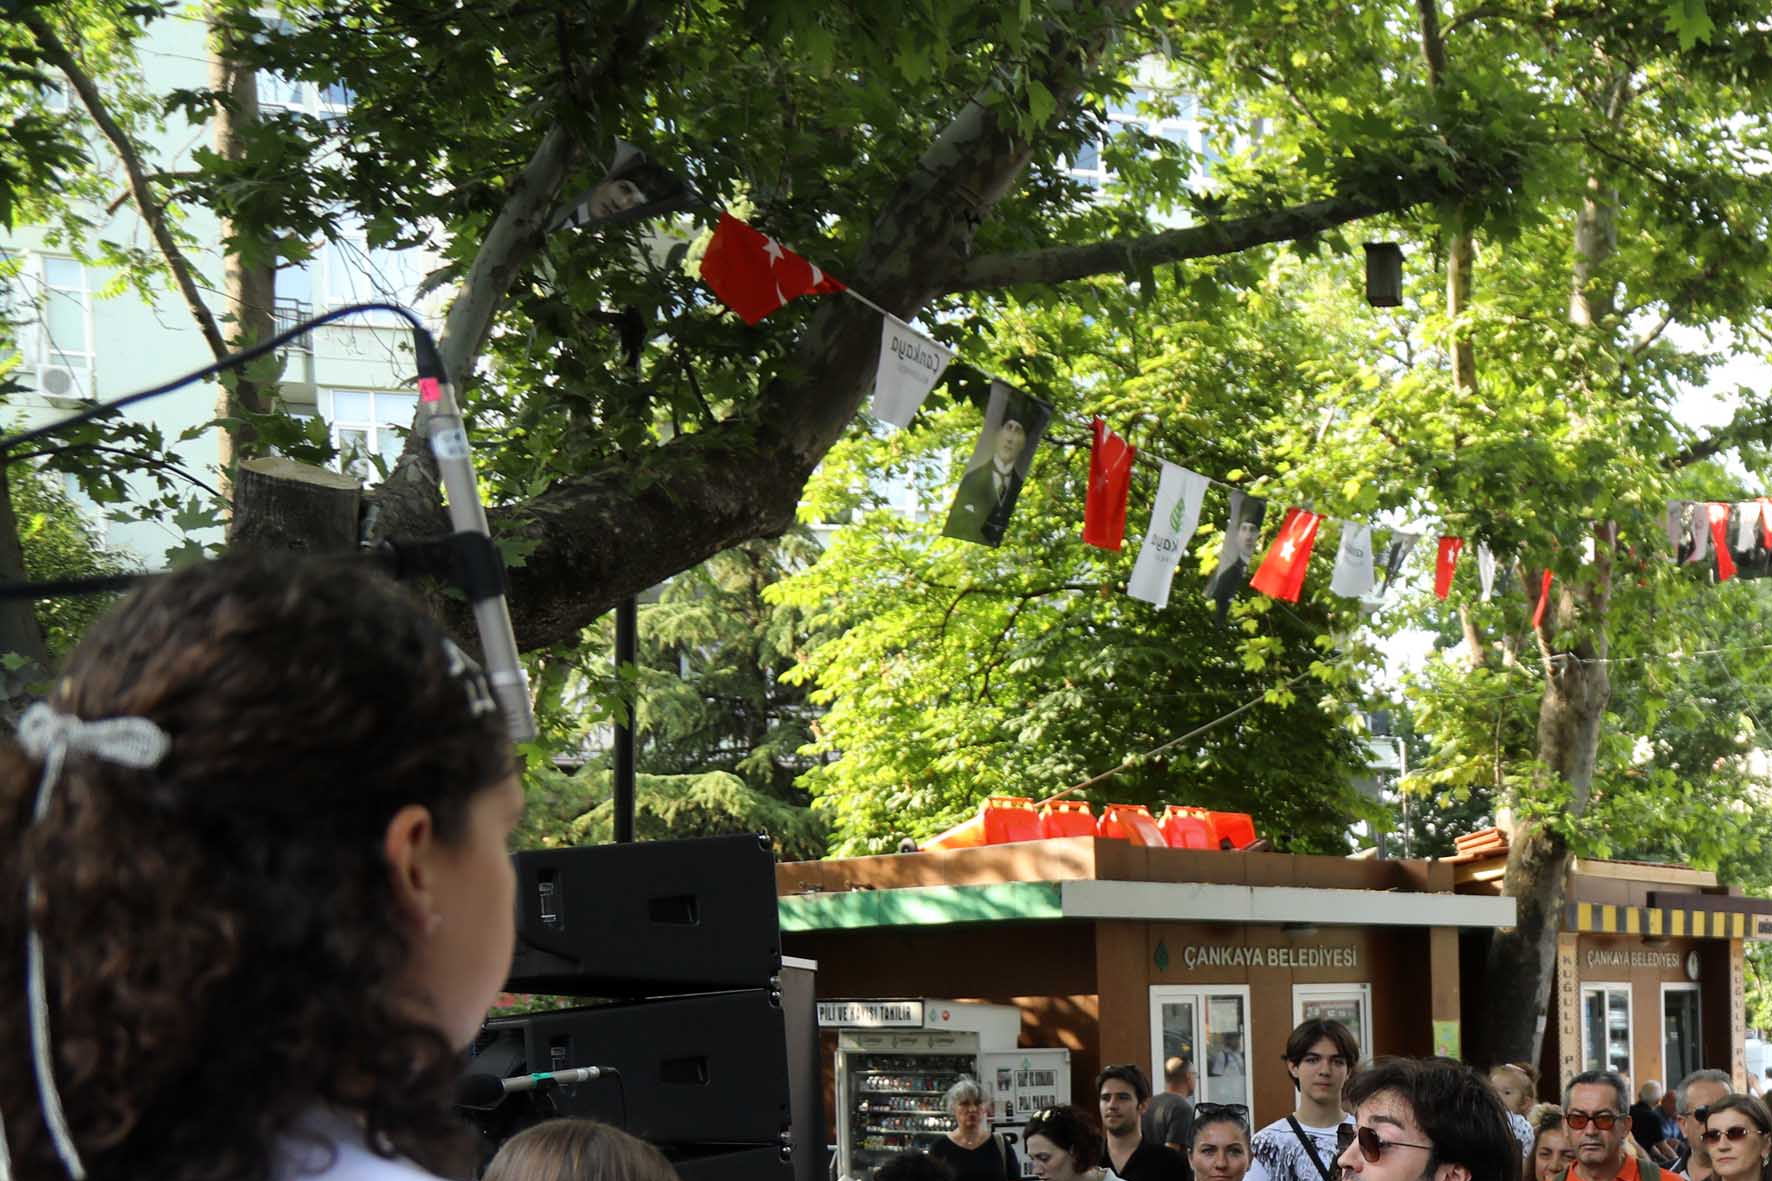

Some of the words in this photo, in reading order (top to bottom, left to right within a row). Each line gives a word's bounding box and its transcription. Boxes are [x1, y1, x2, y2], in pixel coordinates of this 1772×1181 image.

[1183, 946, 1264, 970] ÇANKAYA
[1267, 944, 1358, 967] BELEDİYESİ
[1587, 950, 1630, 968] ÇANKAYA
[1631, 951, 1680, 968] BELEDİYESİ
[838, 1006, 848, 1021] VE
